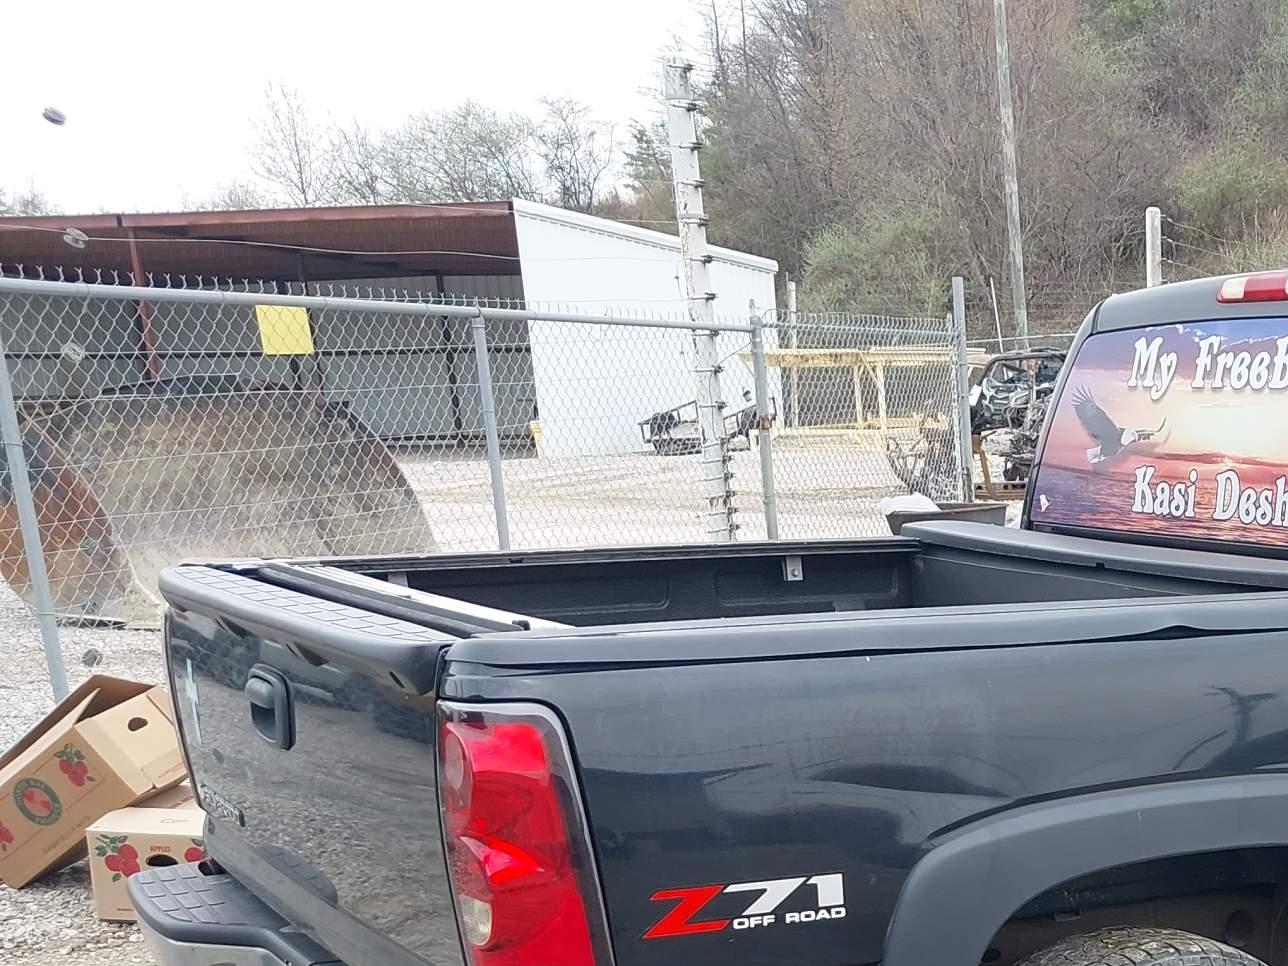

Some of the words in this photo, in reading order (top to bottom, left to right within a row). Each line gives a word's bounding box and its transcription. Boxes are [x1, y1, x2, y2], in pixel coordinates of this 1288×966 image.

[1127, 336, 1178, 402] My
[1131, 464, 1198, 519] Kasi
[150, 845, 172, 853] APPLES
[642, 870, 846, 940] Z71
[732, 914, 776, 930] OFF
[785, 906, 847, 924] ROAD
